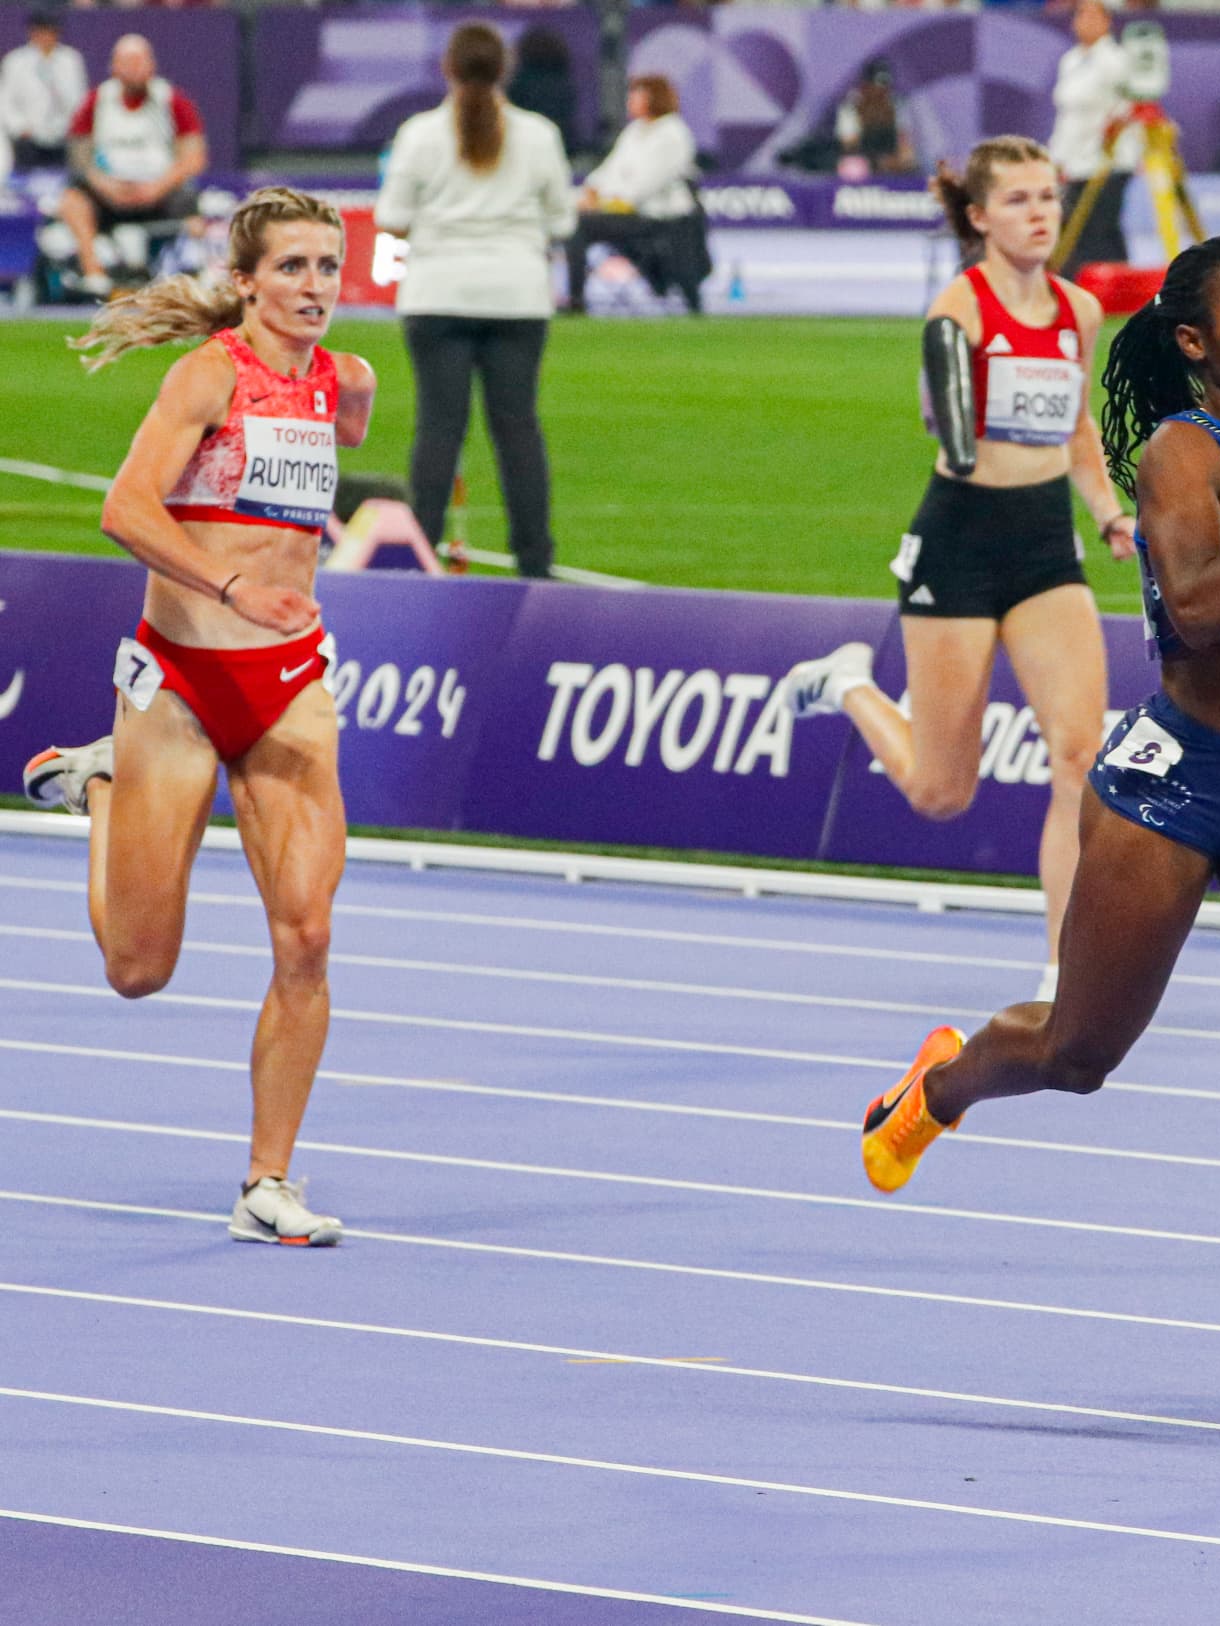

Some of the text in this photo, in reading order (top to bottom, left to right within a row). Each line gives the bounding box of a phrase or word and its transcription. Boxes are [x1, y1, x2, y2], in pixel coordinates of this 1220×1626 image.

[1012, 391, 1070, 418] ROSS
[273, 427, 333, 446] TOYOTA
[129, 654, 148, 689] 7
[334, 659, 467, 739] 2024
[537, 661, 796, 778] TOYOTA
